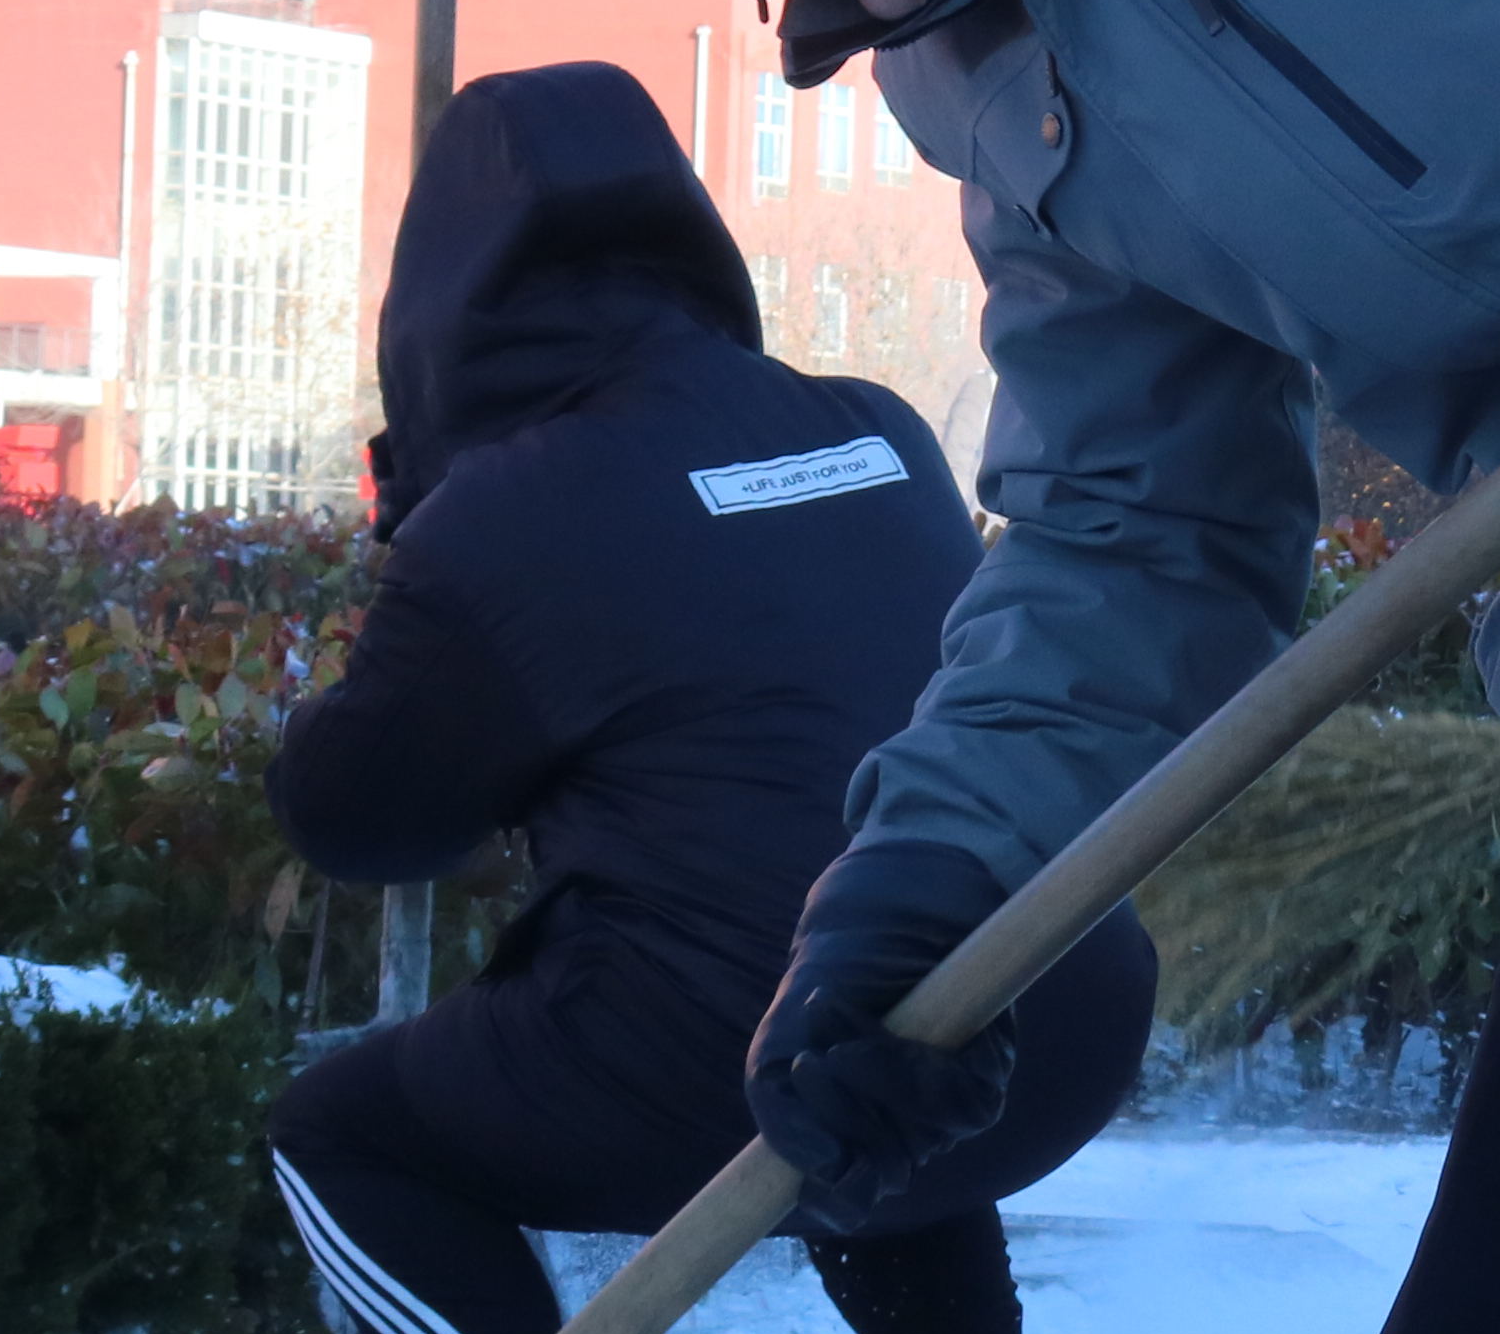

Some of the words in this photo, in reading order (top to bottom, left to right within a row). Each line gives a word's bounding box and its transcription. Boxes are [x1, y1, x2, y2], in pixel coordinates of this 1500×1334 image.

[780, 470, 812, 488] JUST
[812, 464, 841, 481] FOR
[841, 458, 868, 474] YOU
